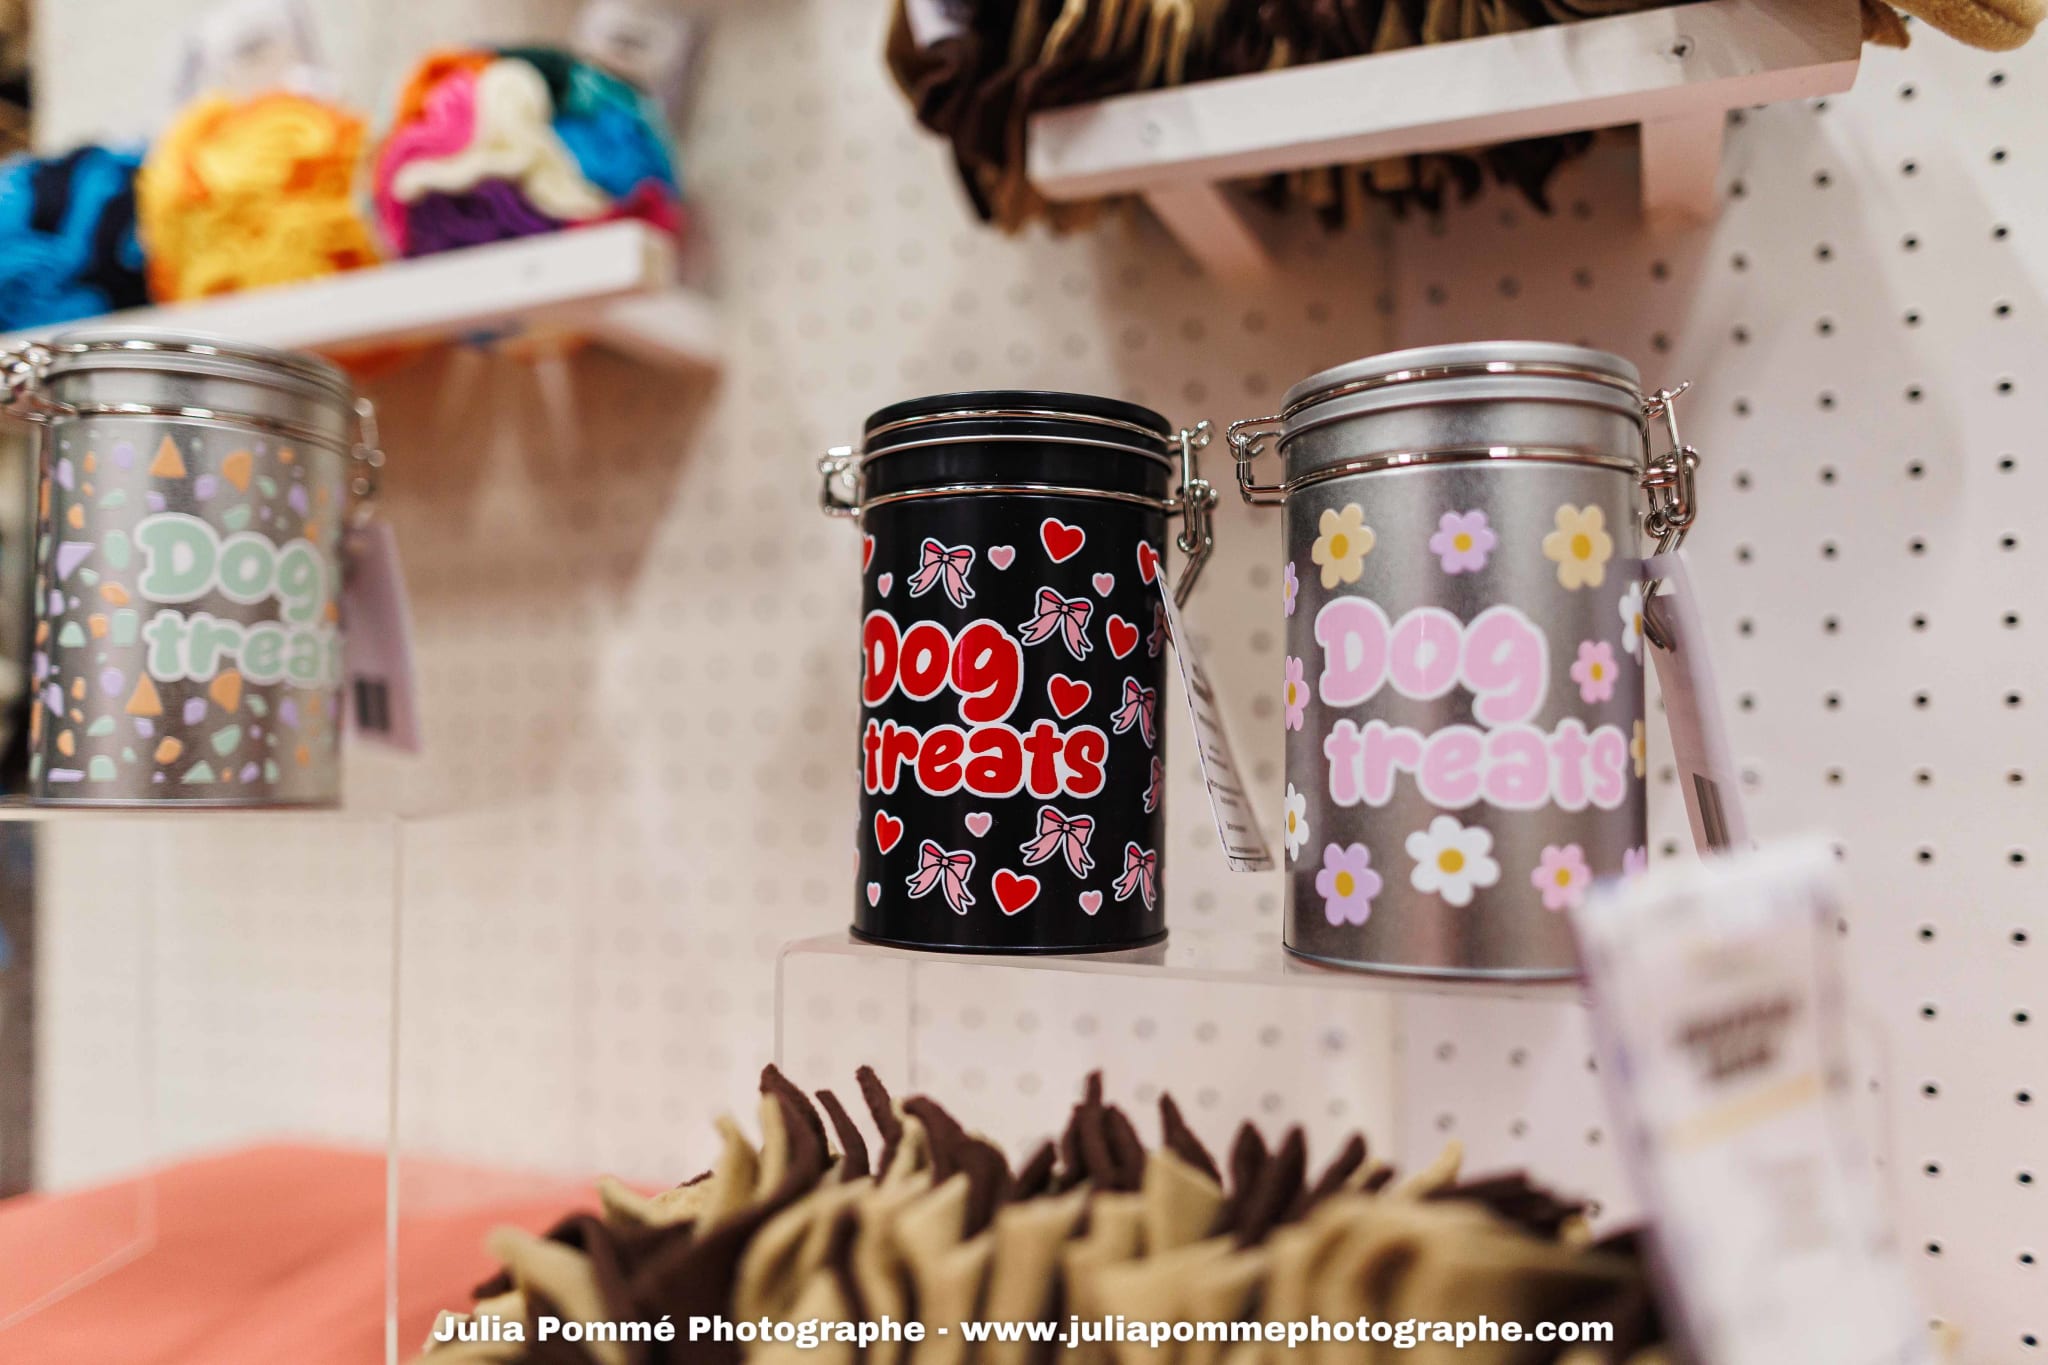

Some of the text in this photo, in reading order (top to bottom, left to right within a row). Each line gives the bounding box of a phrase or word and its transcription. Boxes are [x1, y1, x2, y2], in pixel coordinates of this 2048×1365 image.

[136, 515, 325, 623] Dog
[863, 611, 1021, 725] Dog
[1316, 598, 1548, 726] Dog
[864, 720, 1107, 797] treats
[1325, 719, 1626, 810] treats
